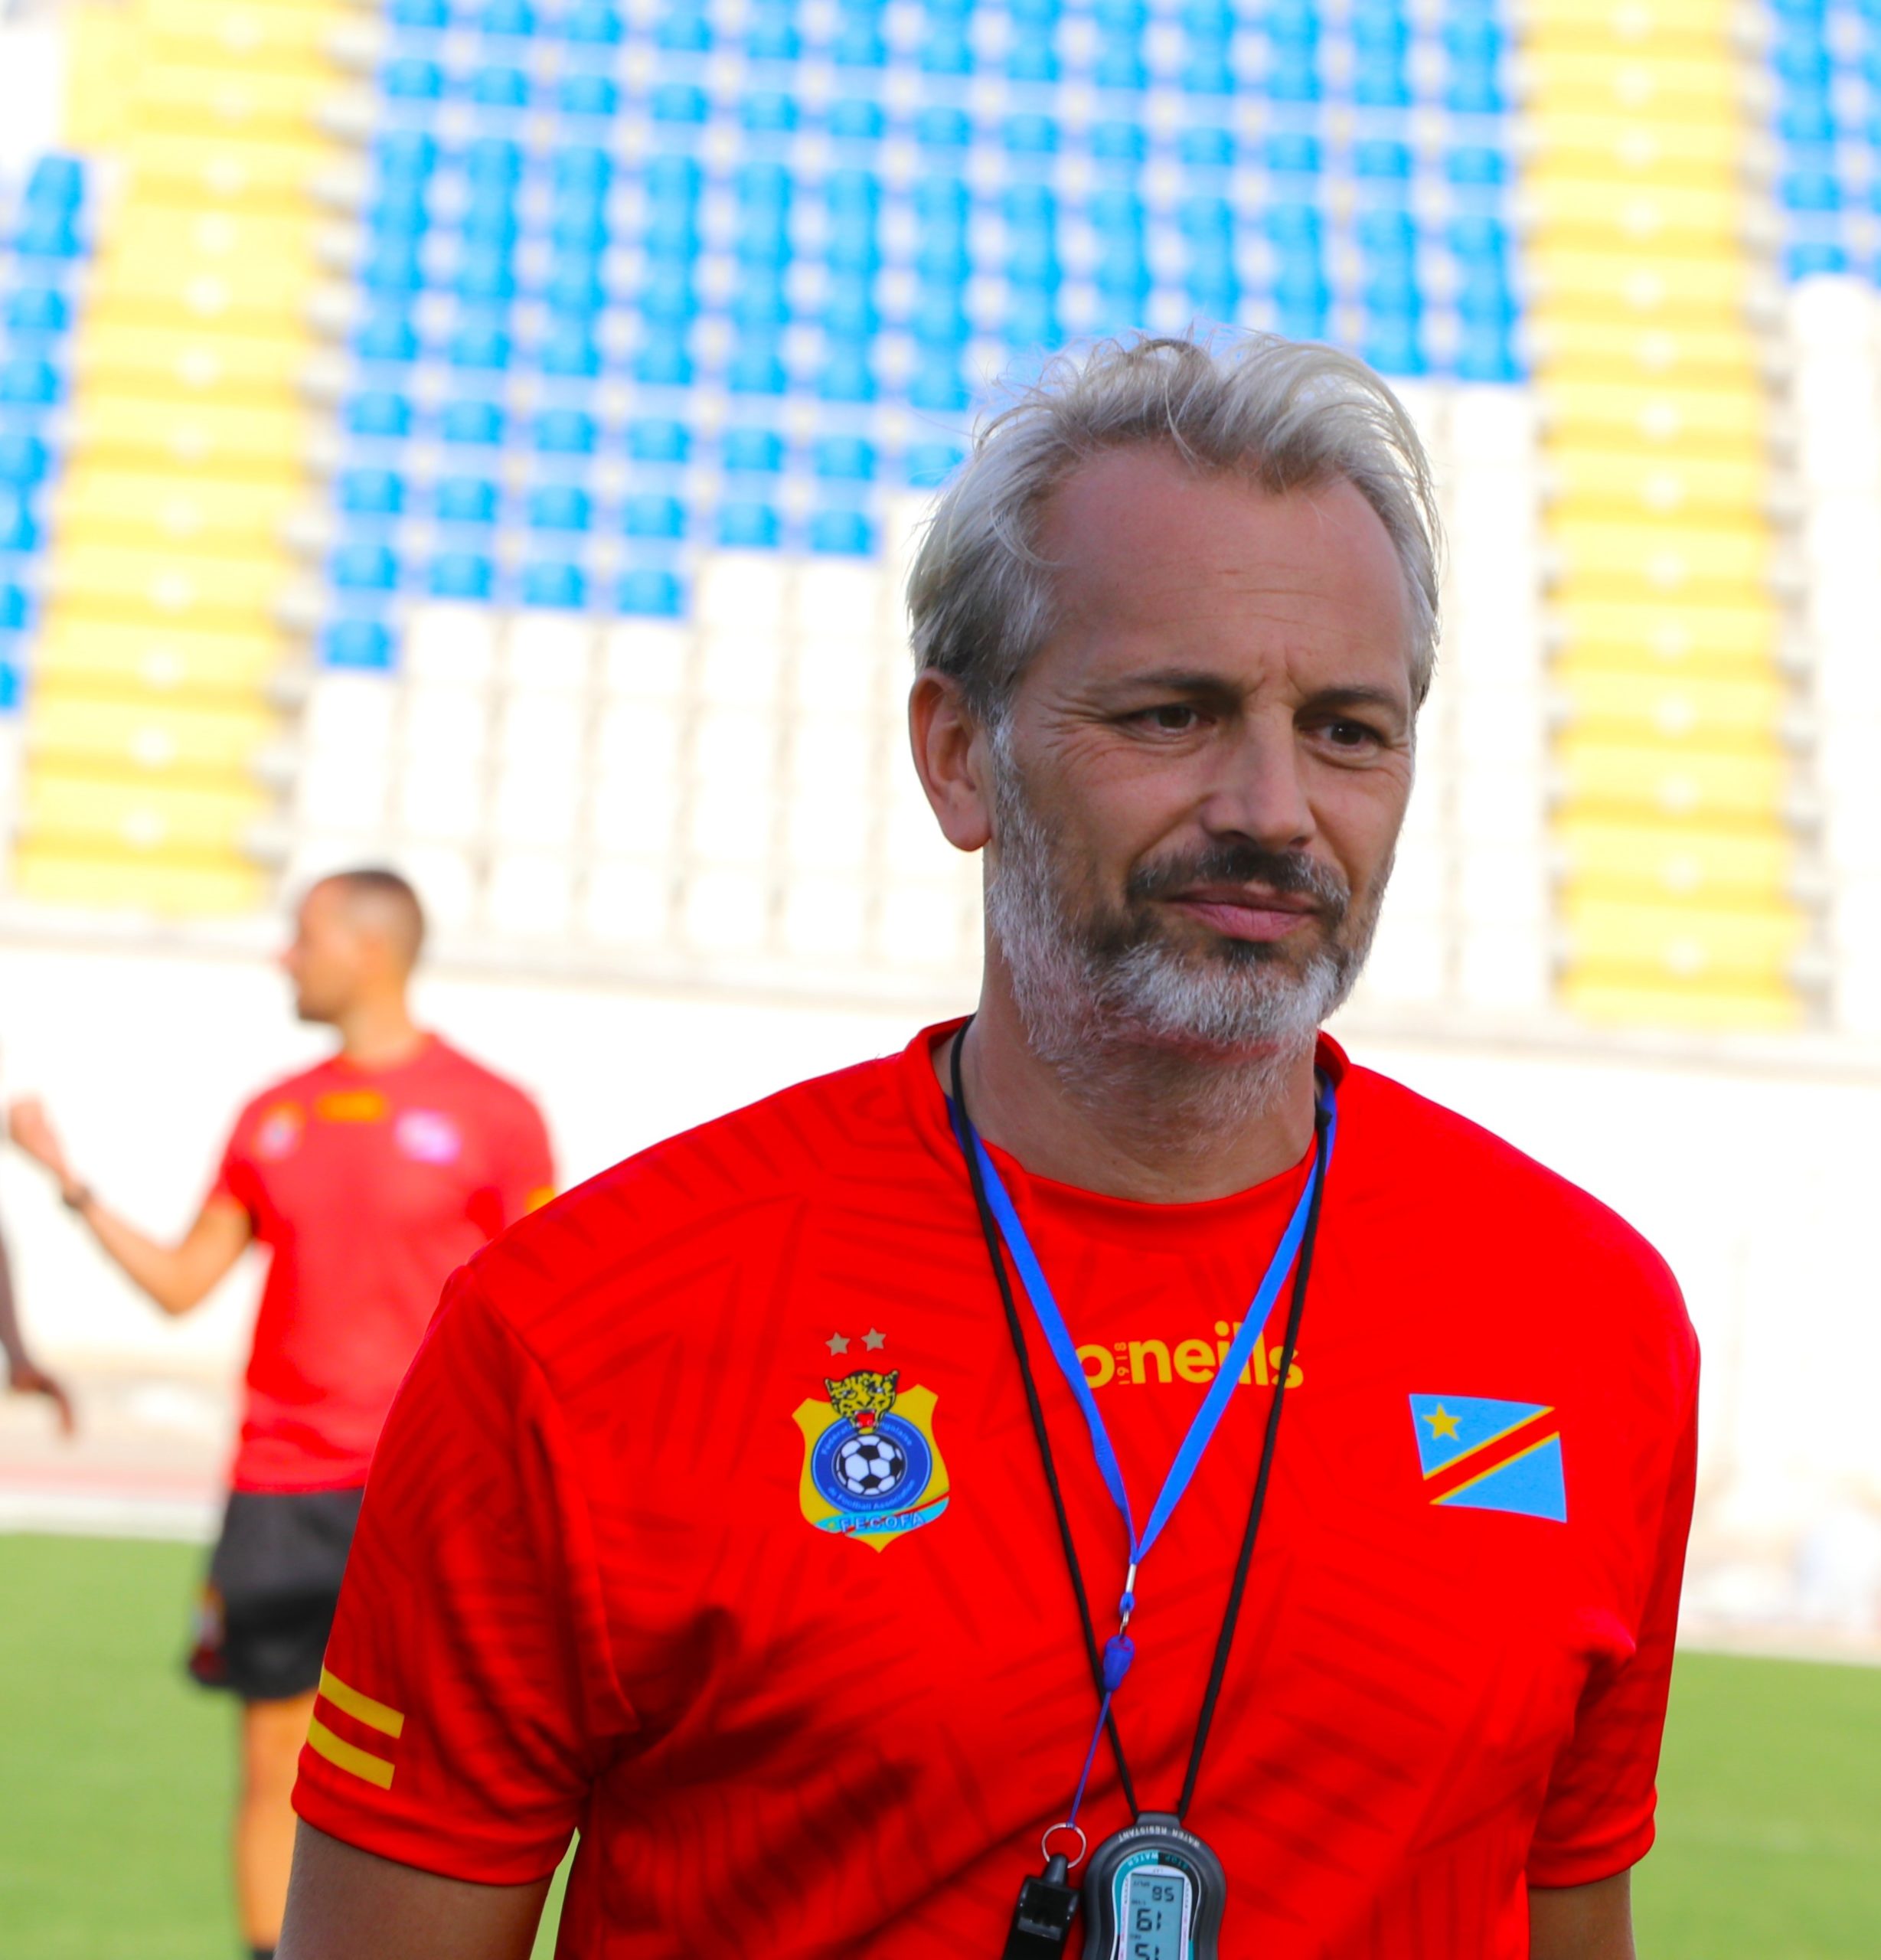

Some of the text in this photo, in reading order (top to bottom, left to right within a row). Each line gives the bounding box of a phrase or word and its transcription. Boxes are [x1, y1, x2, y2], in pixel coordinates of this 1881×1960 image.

[1075, 1321, 1304, 1389] oneils
[841, 1511, 926, 1534] FECOFA
[1118, 1825, 1201, 1848] WATER RESISTANT
